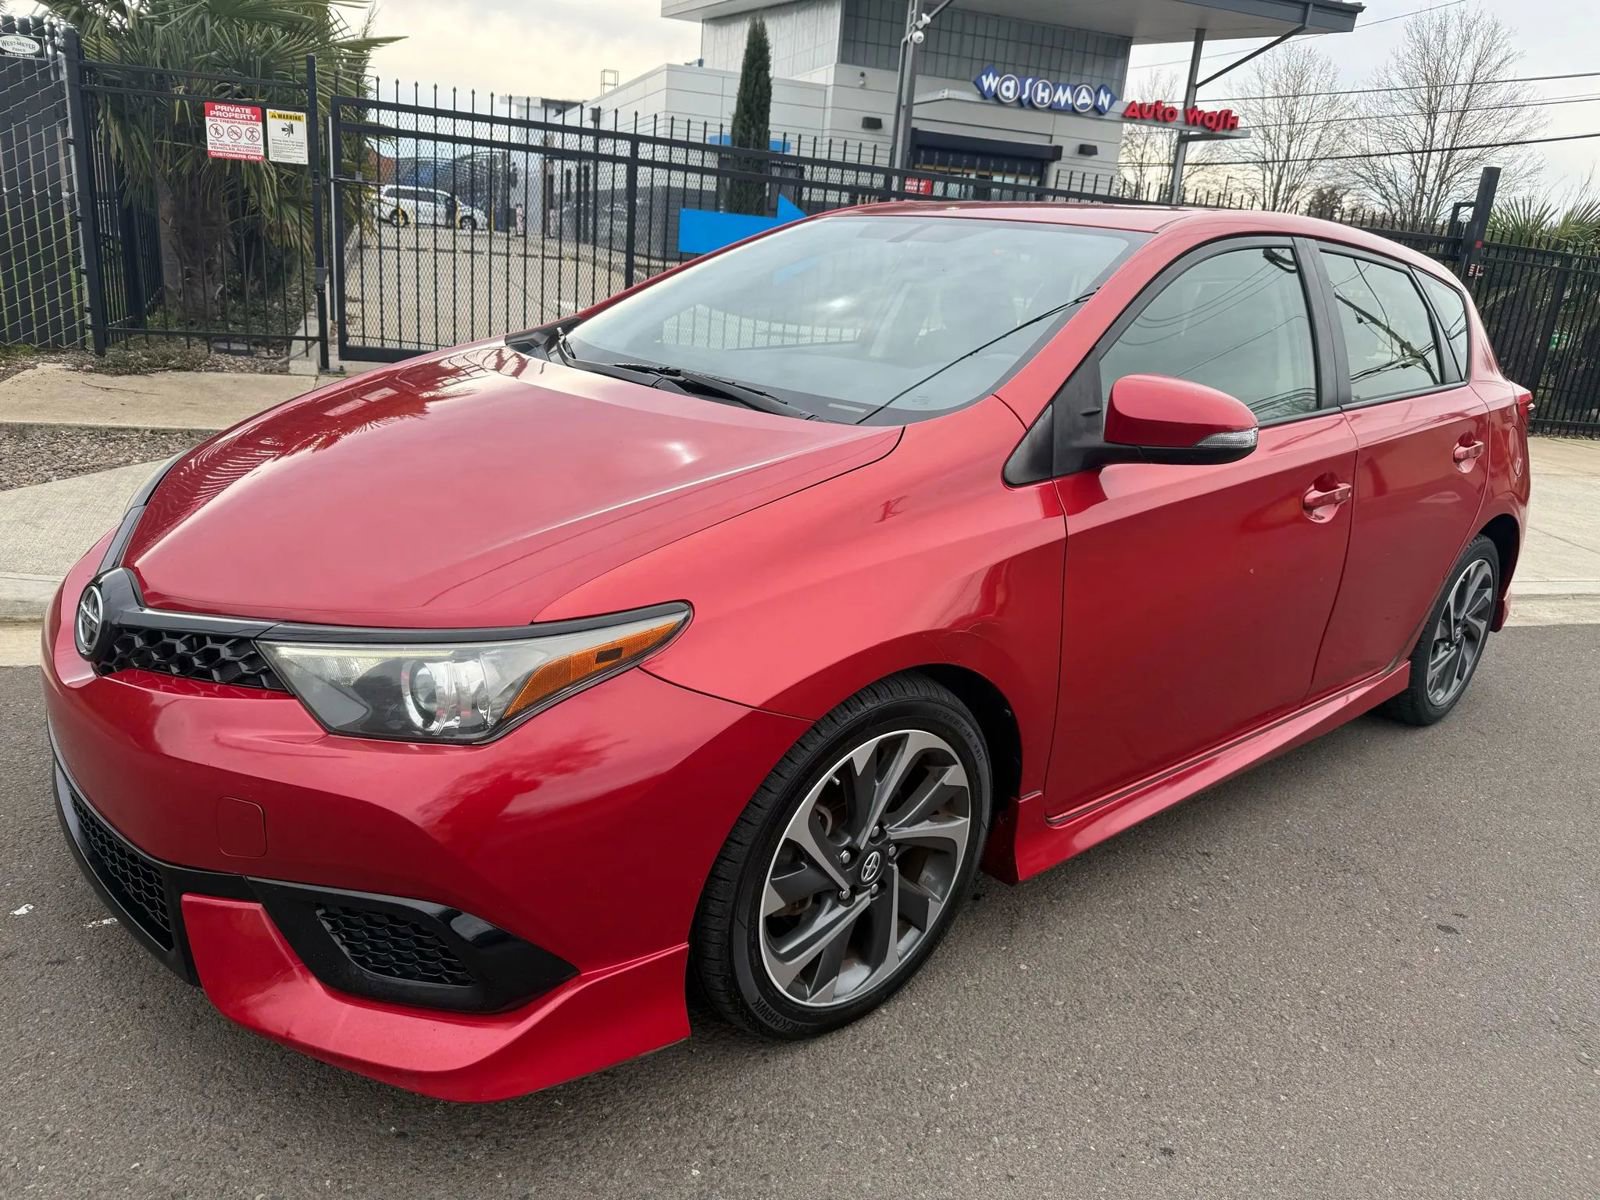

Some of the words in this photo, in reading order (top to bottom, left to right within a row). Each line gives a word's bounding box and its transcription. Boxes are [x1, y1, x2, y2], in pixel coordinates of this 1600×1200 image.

[214, 104, 252, 114] PRIVATE
[1122, 100, 1179, 122] Auto
[210, 110, 257, 120] PROPERTY
[210, 151, 247, 159] CUSTOMERS
